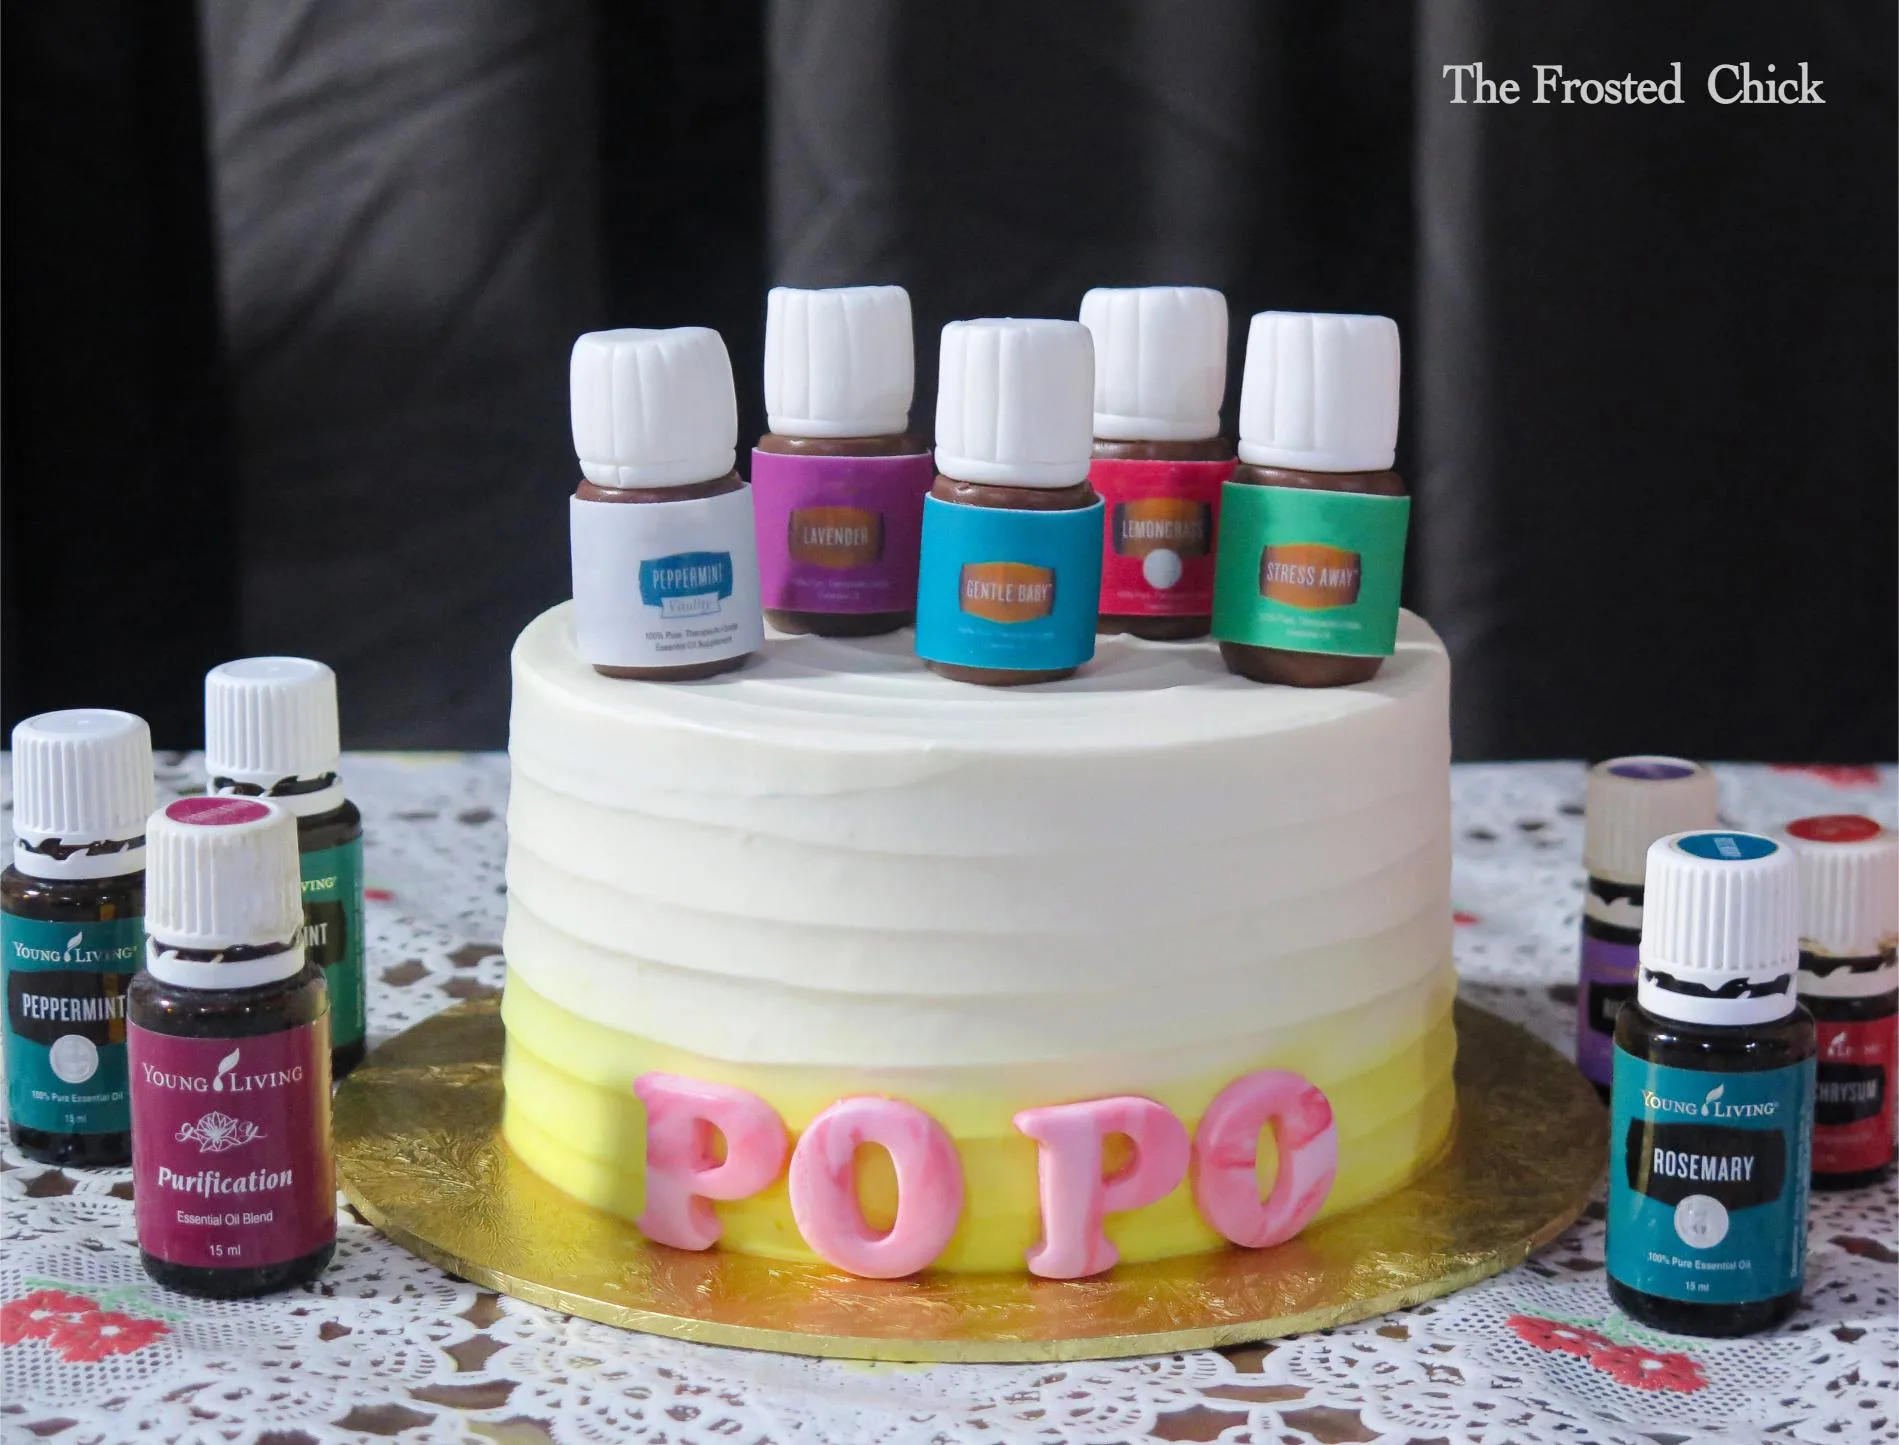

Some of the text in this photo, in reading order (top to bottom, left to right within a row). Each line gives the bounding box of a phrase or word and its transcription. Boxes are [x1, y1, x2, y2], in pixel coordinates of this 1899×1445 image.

[802, 526, 869, 546] LAVENDER
[652, 563, 722, 590] PEPPERMINT
[1266, 562, 1316, 586] STRESS
[966, 579, 1013, 602] GENTLE
[21, 992, 126, 1022] PEPPERMINT
[1653, 1147, 1756, 1182] ROSEMARY
[158, 1166, 294, 1199] Purification
[177, 1210, 274, 1226] Essential Oil Blend
[209, 1244, 242, 1256] 15 ml
[1647, 1251, 1671, 1265] 100%
[1671, 1256, 1693, 1269] Pure
[1695, 1259, 1737, 1270] Essential
